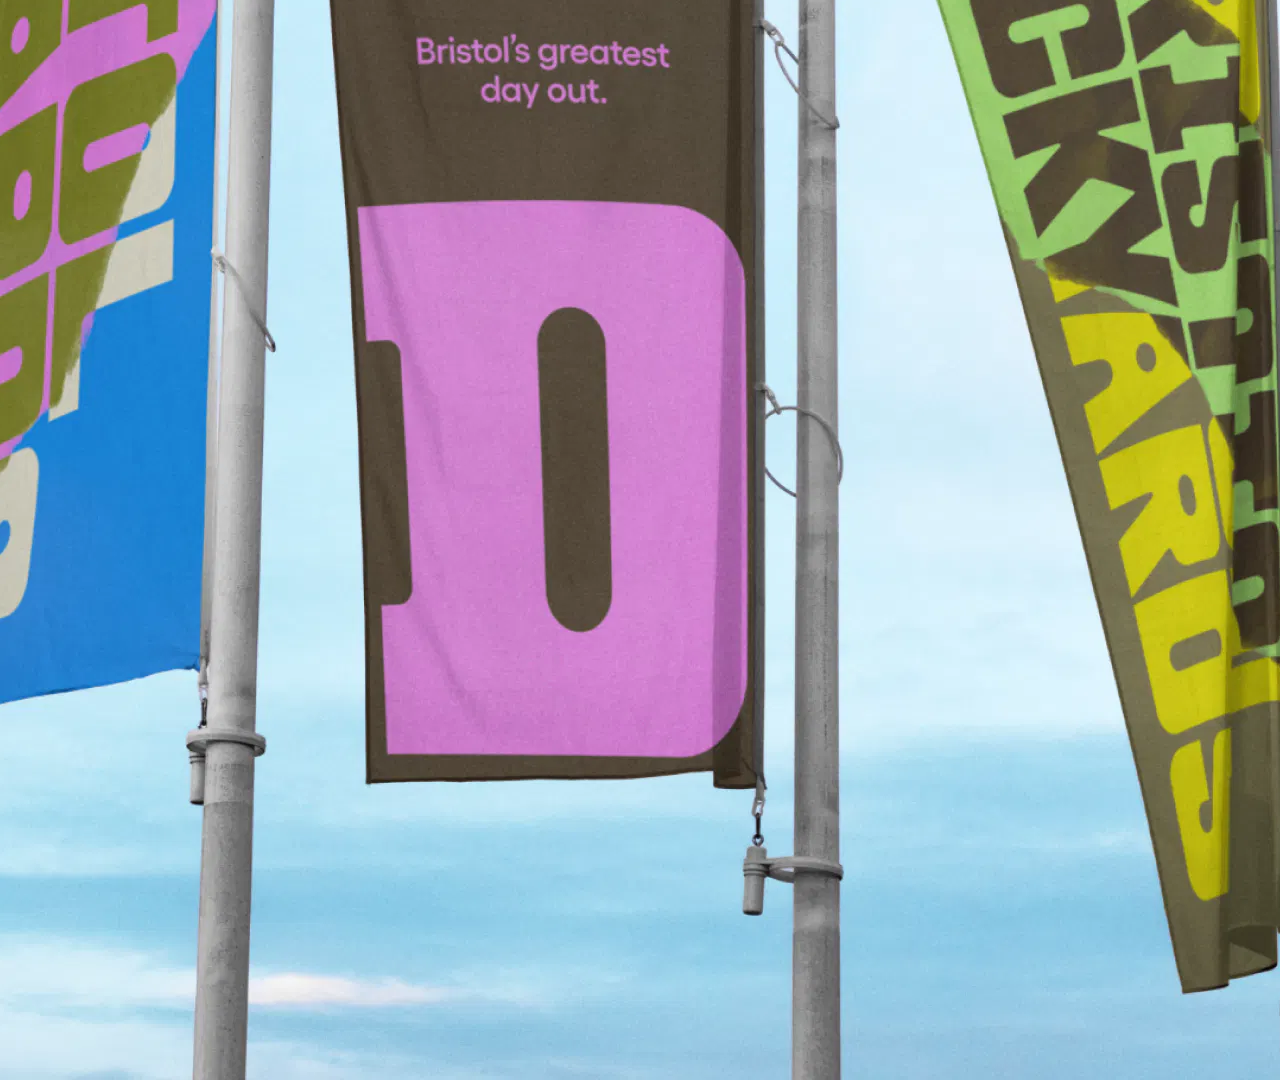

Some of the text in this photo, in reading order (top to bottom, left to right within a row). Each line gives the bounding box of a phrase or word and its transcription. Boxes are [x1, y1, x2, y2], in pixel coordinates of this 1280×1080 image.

[416, 33, 671, 71] Bristol’s greatest
[480, 75, 608, 109] day out.
[356, 199, 748, 757] D
